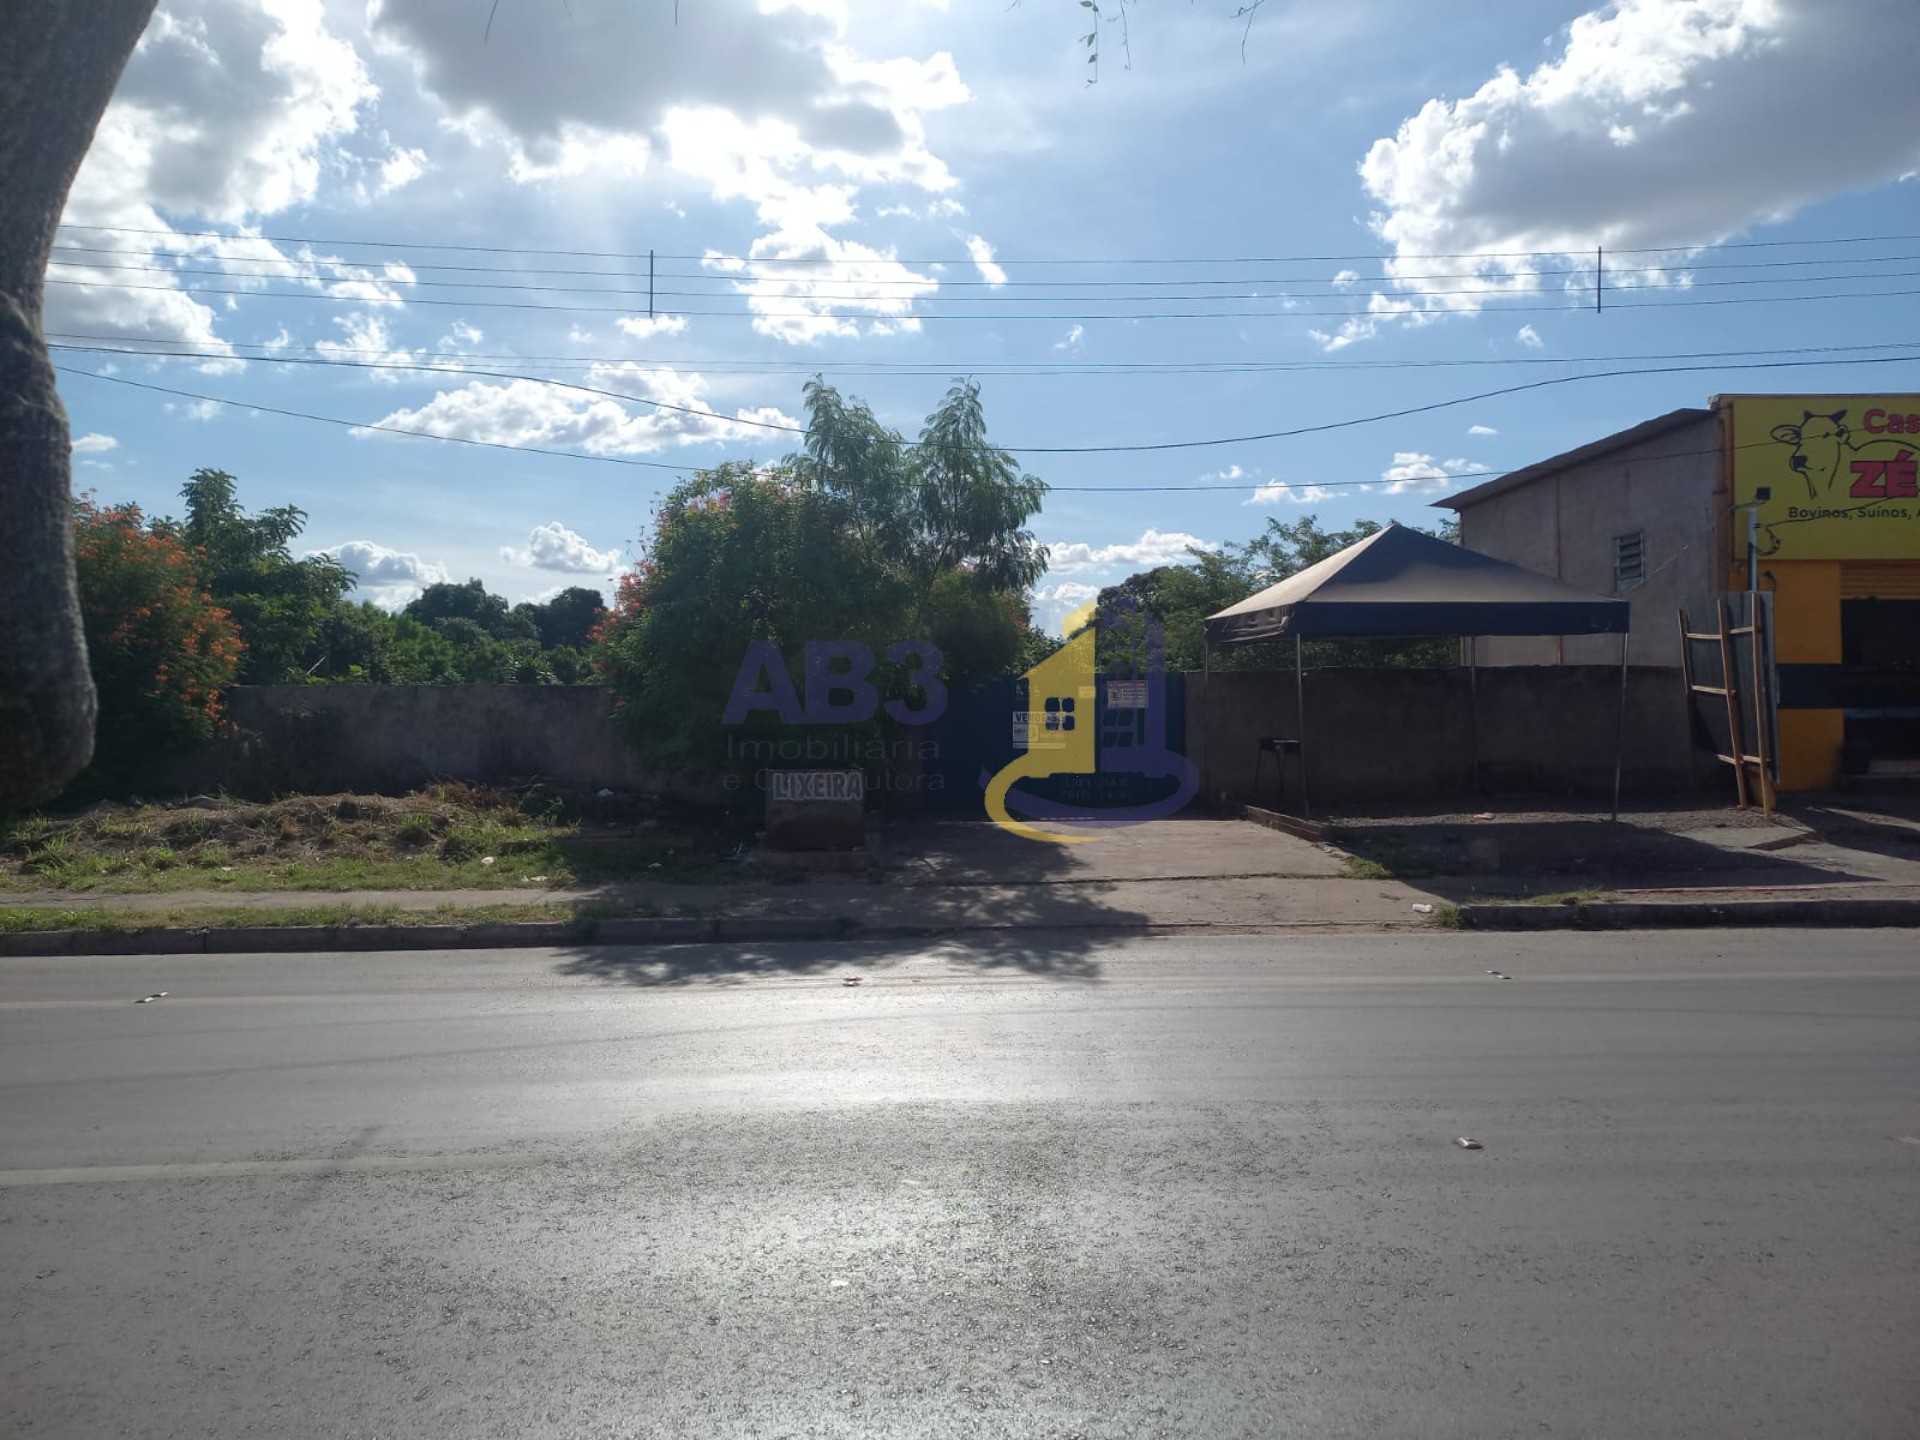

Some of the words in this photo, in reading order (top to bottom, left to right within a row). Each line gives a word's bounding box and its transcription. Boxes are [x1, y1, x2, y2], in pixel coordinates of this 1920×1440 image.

[1849, 449, 1918, 498] ZÉ
[1788, 506, 1853, 521] Bovinos,
[1857, 506, 1912, 521] Suínos,
[1015, 712, 1063, 722] VENDE-S
[772, 772, 863, 801] LIXEIRA
